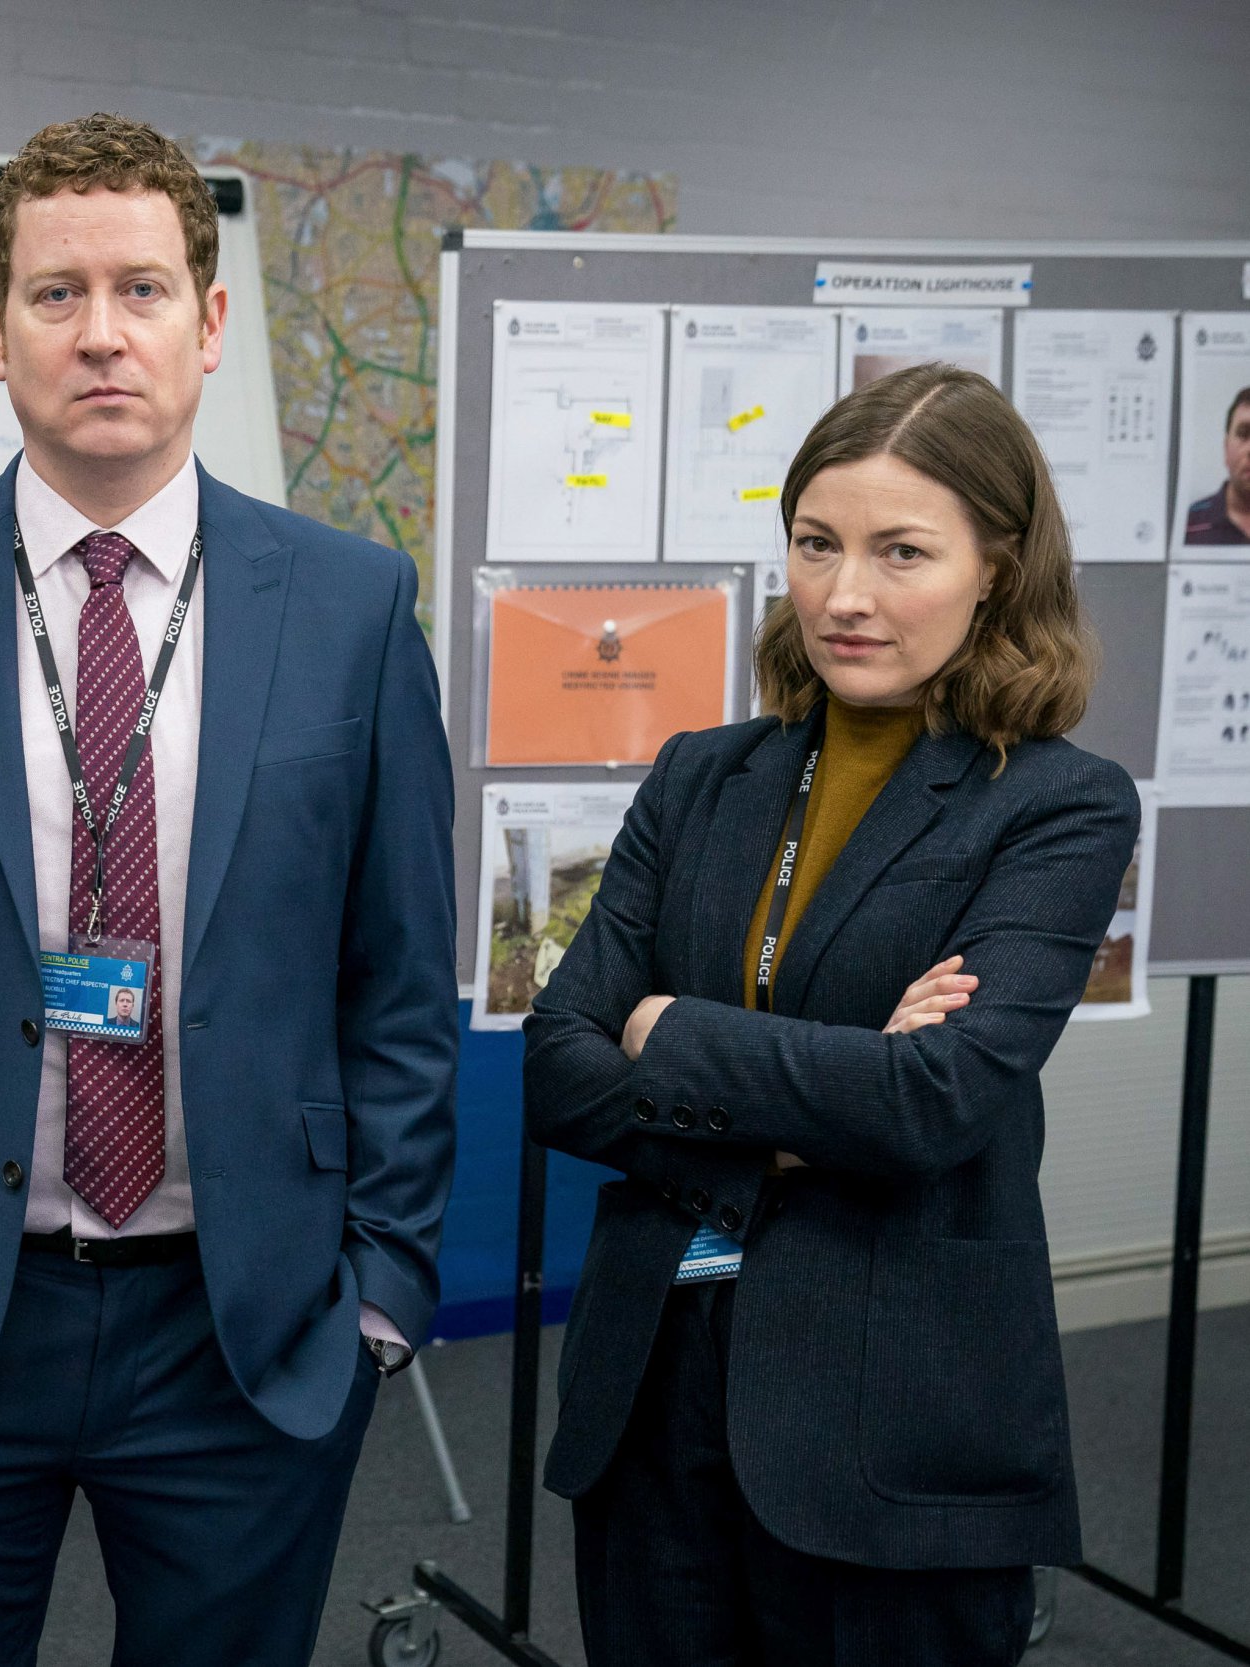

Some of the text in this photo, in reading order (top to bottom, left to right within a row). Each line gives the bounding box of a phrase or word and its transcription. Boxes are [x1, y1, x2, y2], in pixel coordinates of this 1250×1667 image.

[831, 275, 1015, 292] OPERATION LIGHTHOUSE
[25, 591, 45, 637] POLICE
[165, 599, 188, 644] POLICE
[49, 684, 69, 732] POLICE
[135, 689, 159, 736] POLICE
[799, 750, 819, 793] POLICE
[73, 779, 95, 830] POLICE
[105, 783, 128, 832] POLICE
[777, 841, 798, 886] POLICE
[52, 969, 82, 977] Headquarters
[65, 978, 80, 986] CHIEF
[81, 980, 109, 989] INSPECTOR
[68, 957, 90, 966] POLICE
[758, 936, 776, 986] POLICE
